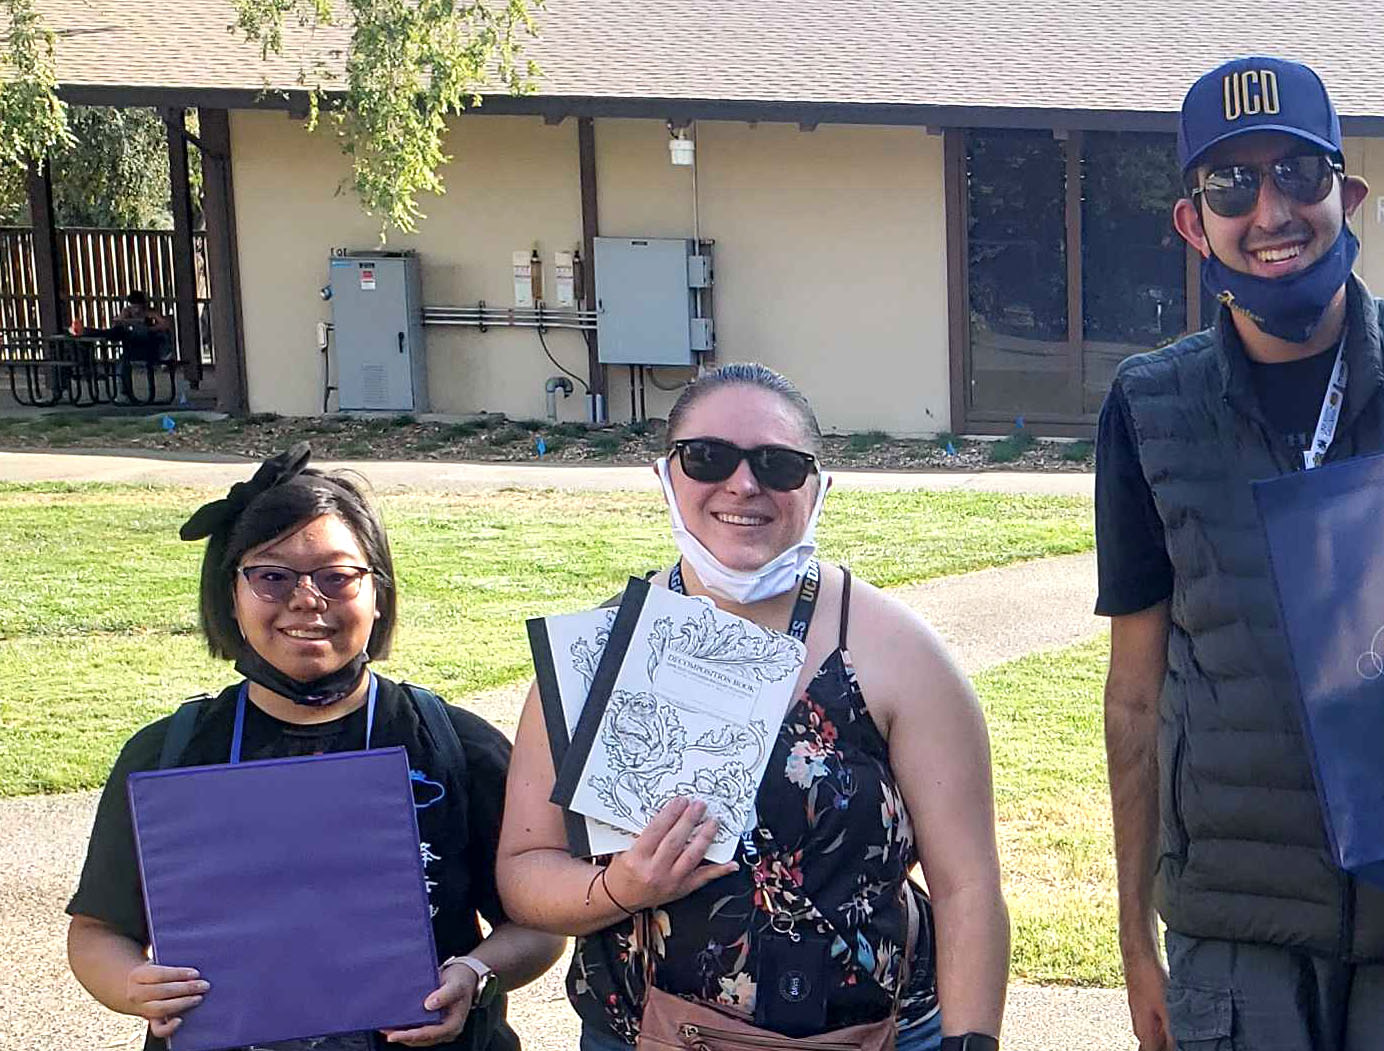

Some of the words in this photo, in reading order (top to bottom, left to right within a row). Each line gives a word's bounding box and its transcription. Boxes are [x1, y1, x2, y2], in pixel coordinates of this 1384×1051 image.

[1223, 69, 1280, 121] UCD
[667, 654, 732, 685] DECOMPOSITION
[732, 678, 756, 693] BOOK
